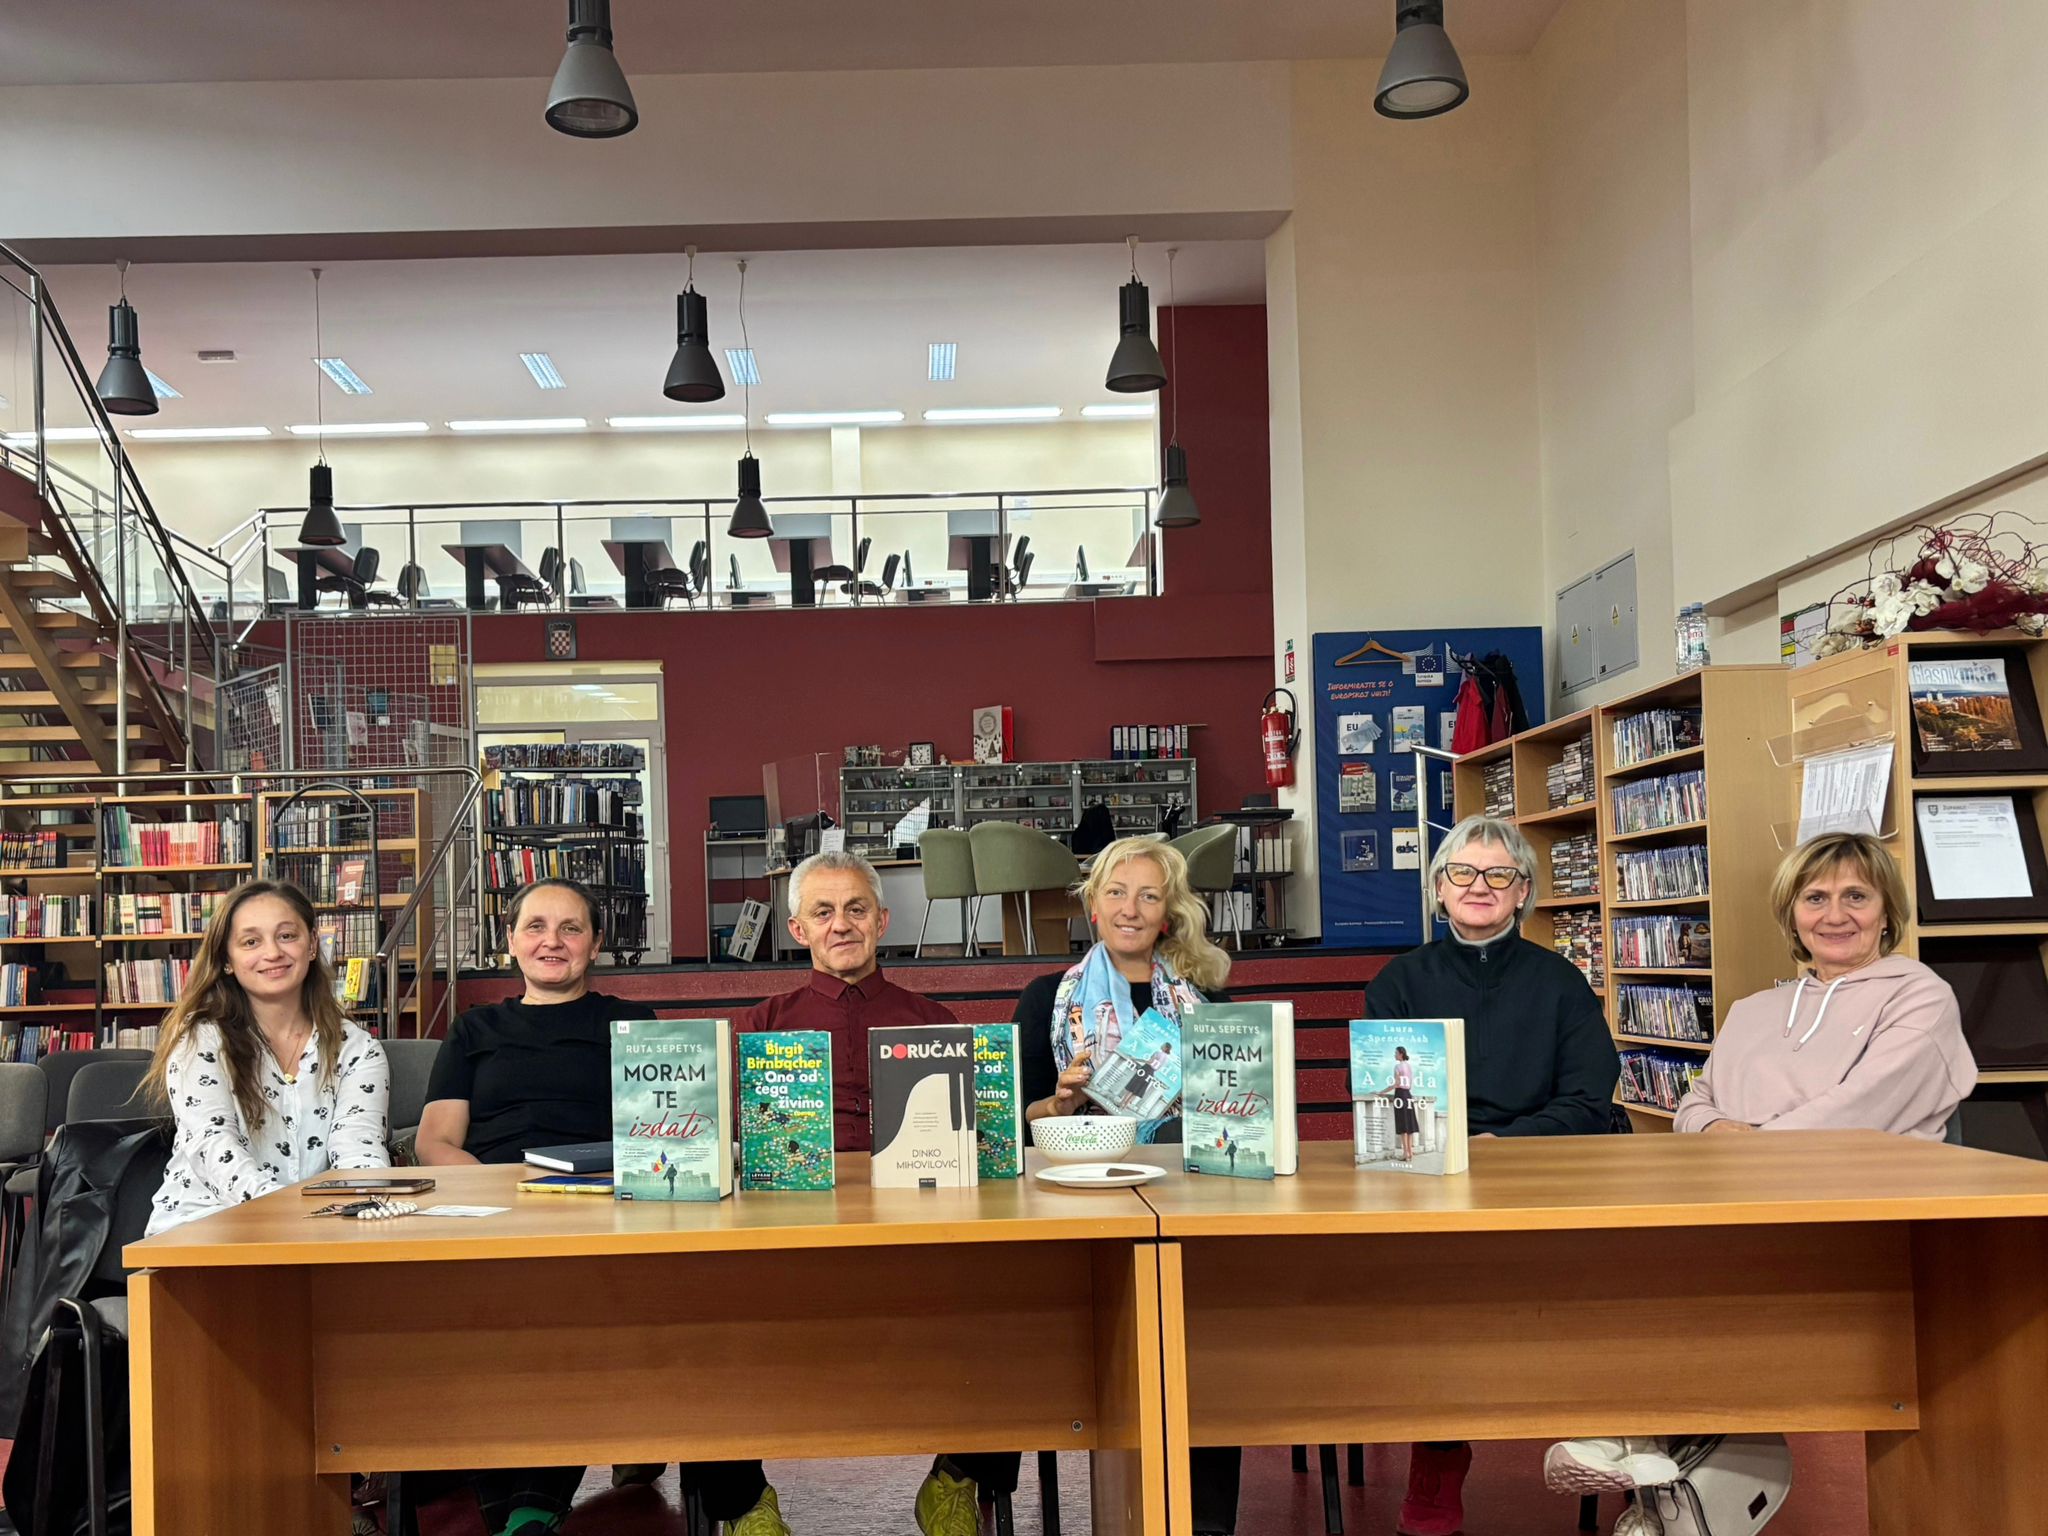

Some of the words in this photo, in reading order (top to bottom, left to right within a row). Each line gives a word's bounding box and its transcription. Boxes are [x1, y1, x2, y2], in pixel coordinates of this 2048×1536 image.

[1346, 723, 1359, 731] EU
[1193, 1024, 1216, 1034] RUTA
[1219, 1024, 1261, 1034] SEPETYS
[1383, 1024, 1413, 1033] Laura
[1367, 1034, 1429, 1044] Spence-Ash
[626, 1044, 654, 1053] RUTA
[656, 1044, 703, 1053] SEPETYS
[766, 1042, 804, 1058] Birgit
[880, 1040, 968, 1060] DORUČAK
[1192, 1043, 1262, 1063] MORAM
[747, 1056, 822, 1069] Birnbacher
[984, 1060, 1002, 1073] od
[624, 1064, 706, 1082] MORAM
[765, 1070, 795, 1083] Ono
[799, 1069, 818, 1083] od
[1216, 1069, 1237, 1087] TE
[1362, 1071, 1375, 1086] A
[1386, 1072, 1437, 1088] onda
[755, 1081, 788, 1098] čega
[975, 1086, 1009, 1099] vimo
[652, 1090, 677, 1108] TE
[778, 1095, 824, 1109] živimo
[1196, 1089, 1268, 1117] izdati
[1374, 1096, 1429, 1110] more
[629, 1109, 714, 1140] izdati
[912, 1149, 942, 1158] DINKO
[896, 1158, 958, 1169] MIHOVILOVIĆ
